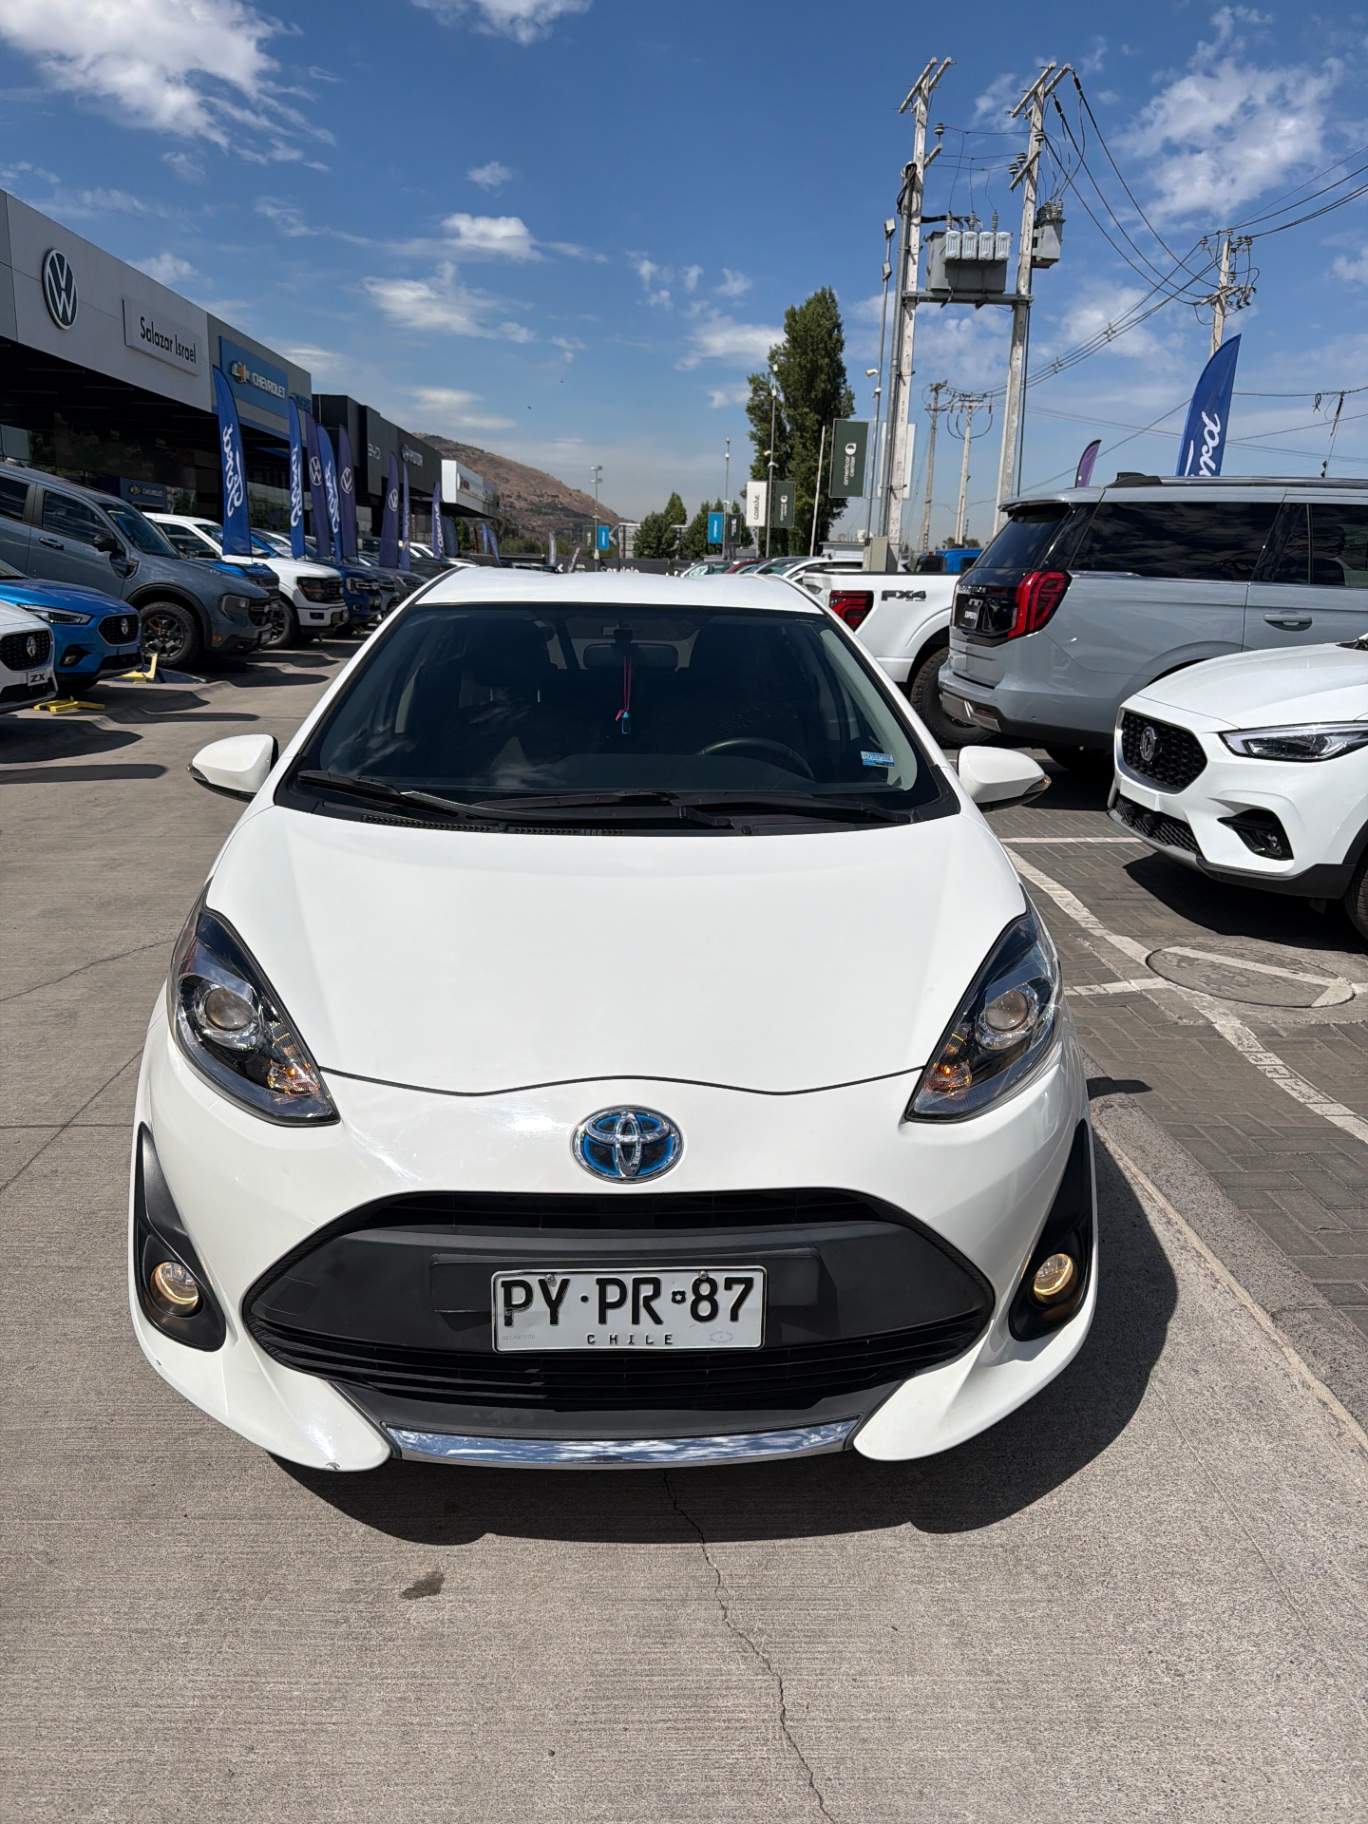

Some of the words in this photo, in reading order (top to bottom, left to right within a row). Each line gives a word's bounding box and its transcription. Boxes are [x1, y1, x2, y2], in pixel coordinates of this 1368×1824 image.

[140, 316, 173, 353] Salazar
[175, 335, 197, 364] Israel
[251, 372, 287, 400] CHEVROLET
[222, 423, 245, 518] Ford
[881, 590, 927, 601] FX4
[30, 673, 46, 683] ZX
[586, 1333, 674, 1346] CHILE
